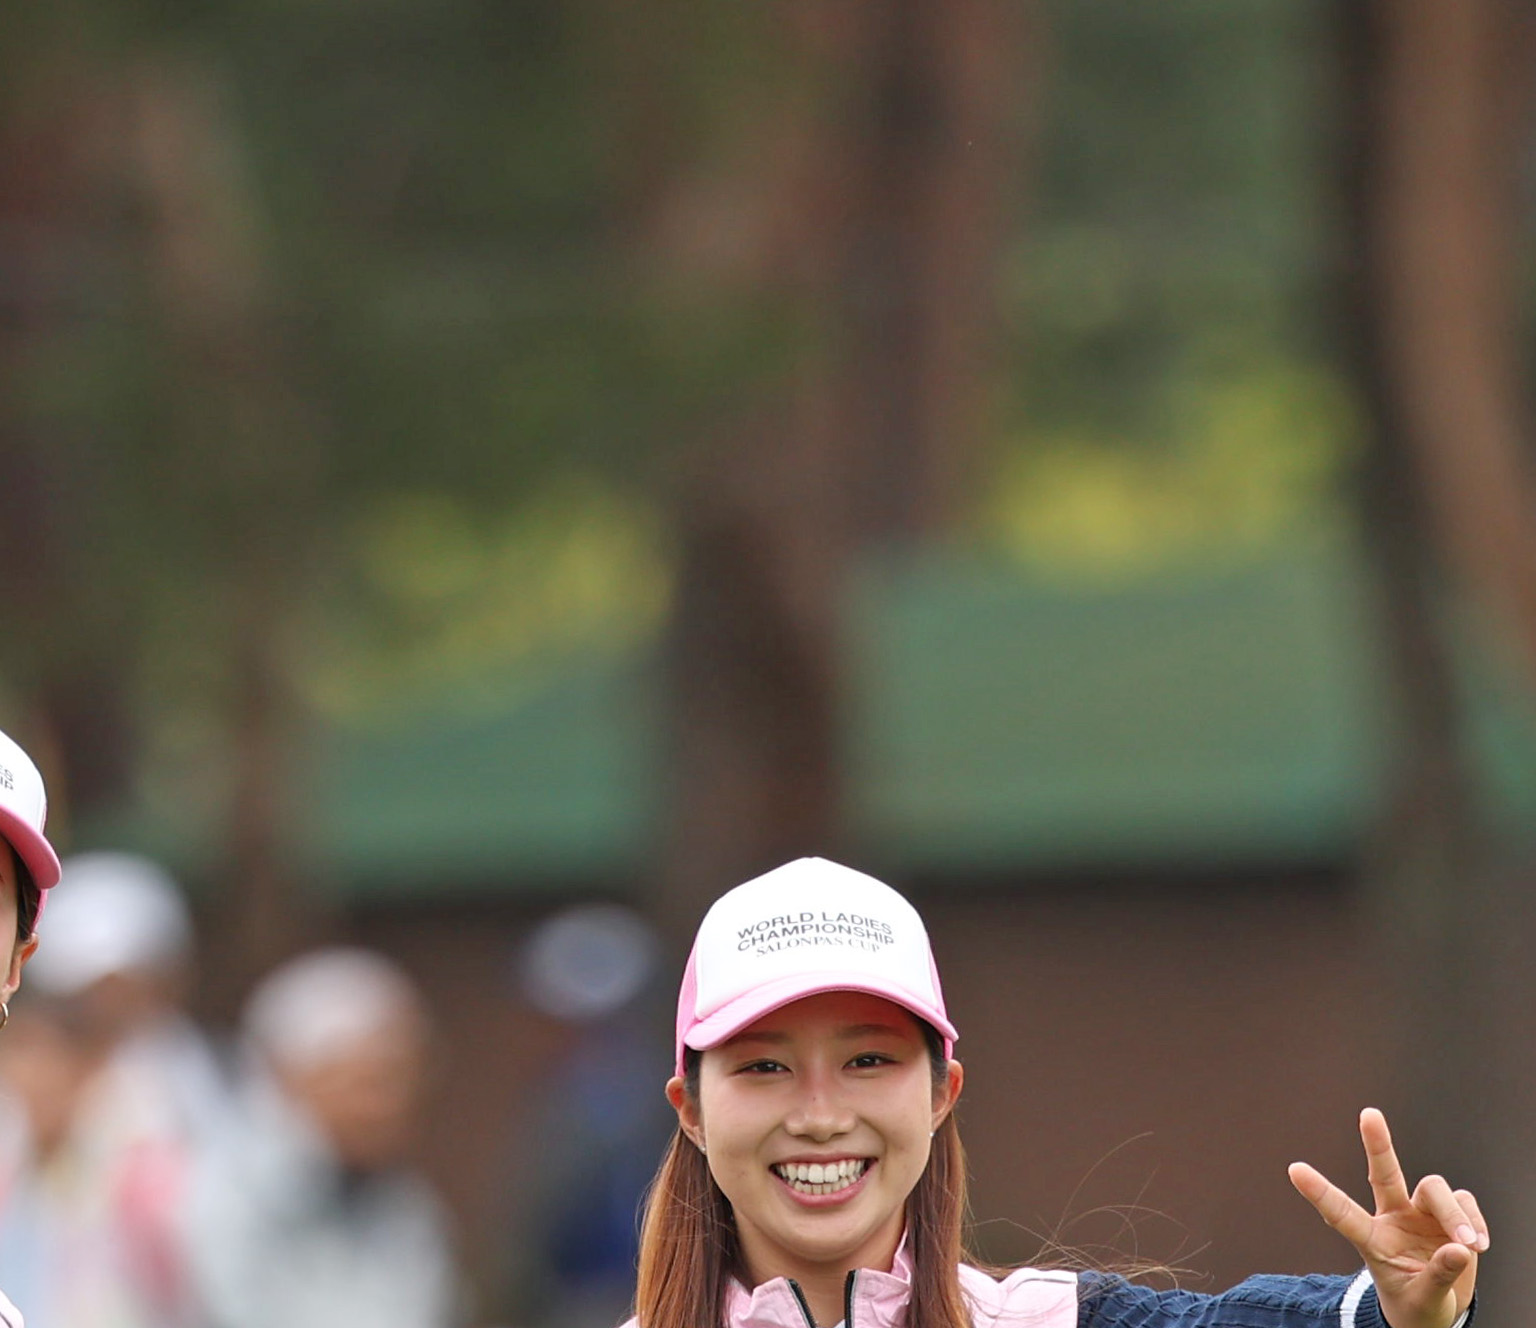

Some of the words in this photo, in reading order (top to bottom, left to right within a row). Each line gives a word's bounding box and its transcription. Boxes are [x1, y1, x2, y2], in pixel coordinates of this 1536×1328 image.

[737, 912, 814, 940] WORLD
[822, 911, 892, 935] LADIES
[737, 923, 894, 951] CHAMPIONSHIP
[756, 936, 843, 958] SALONPAS
[848, 938, 880, 953] CUP
